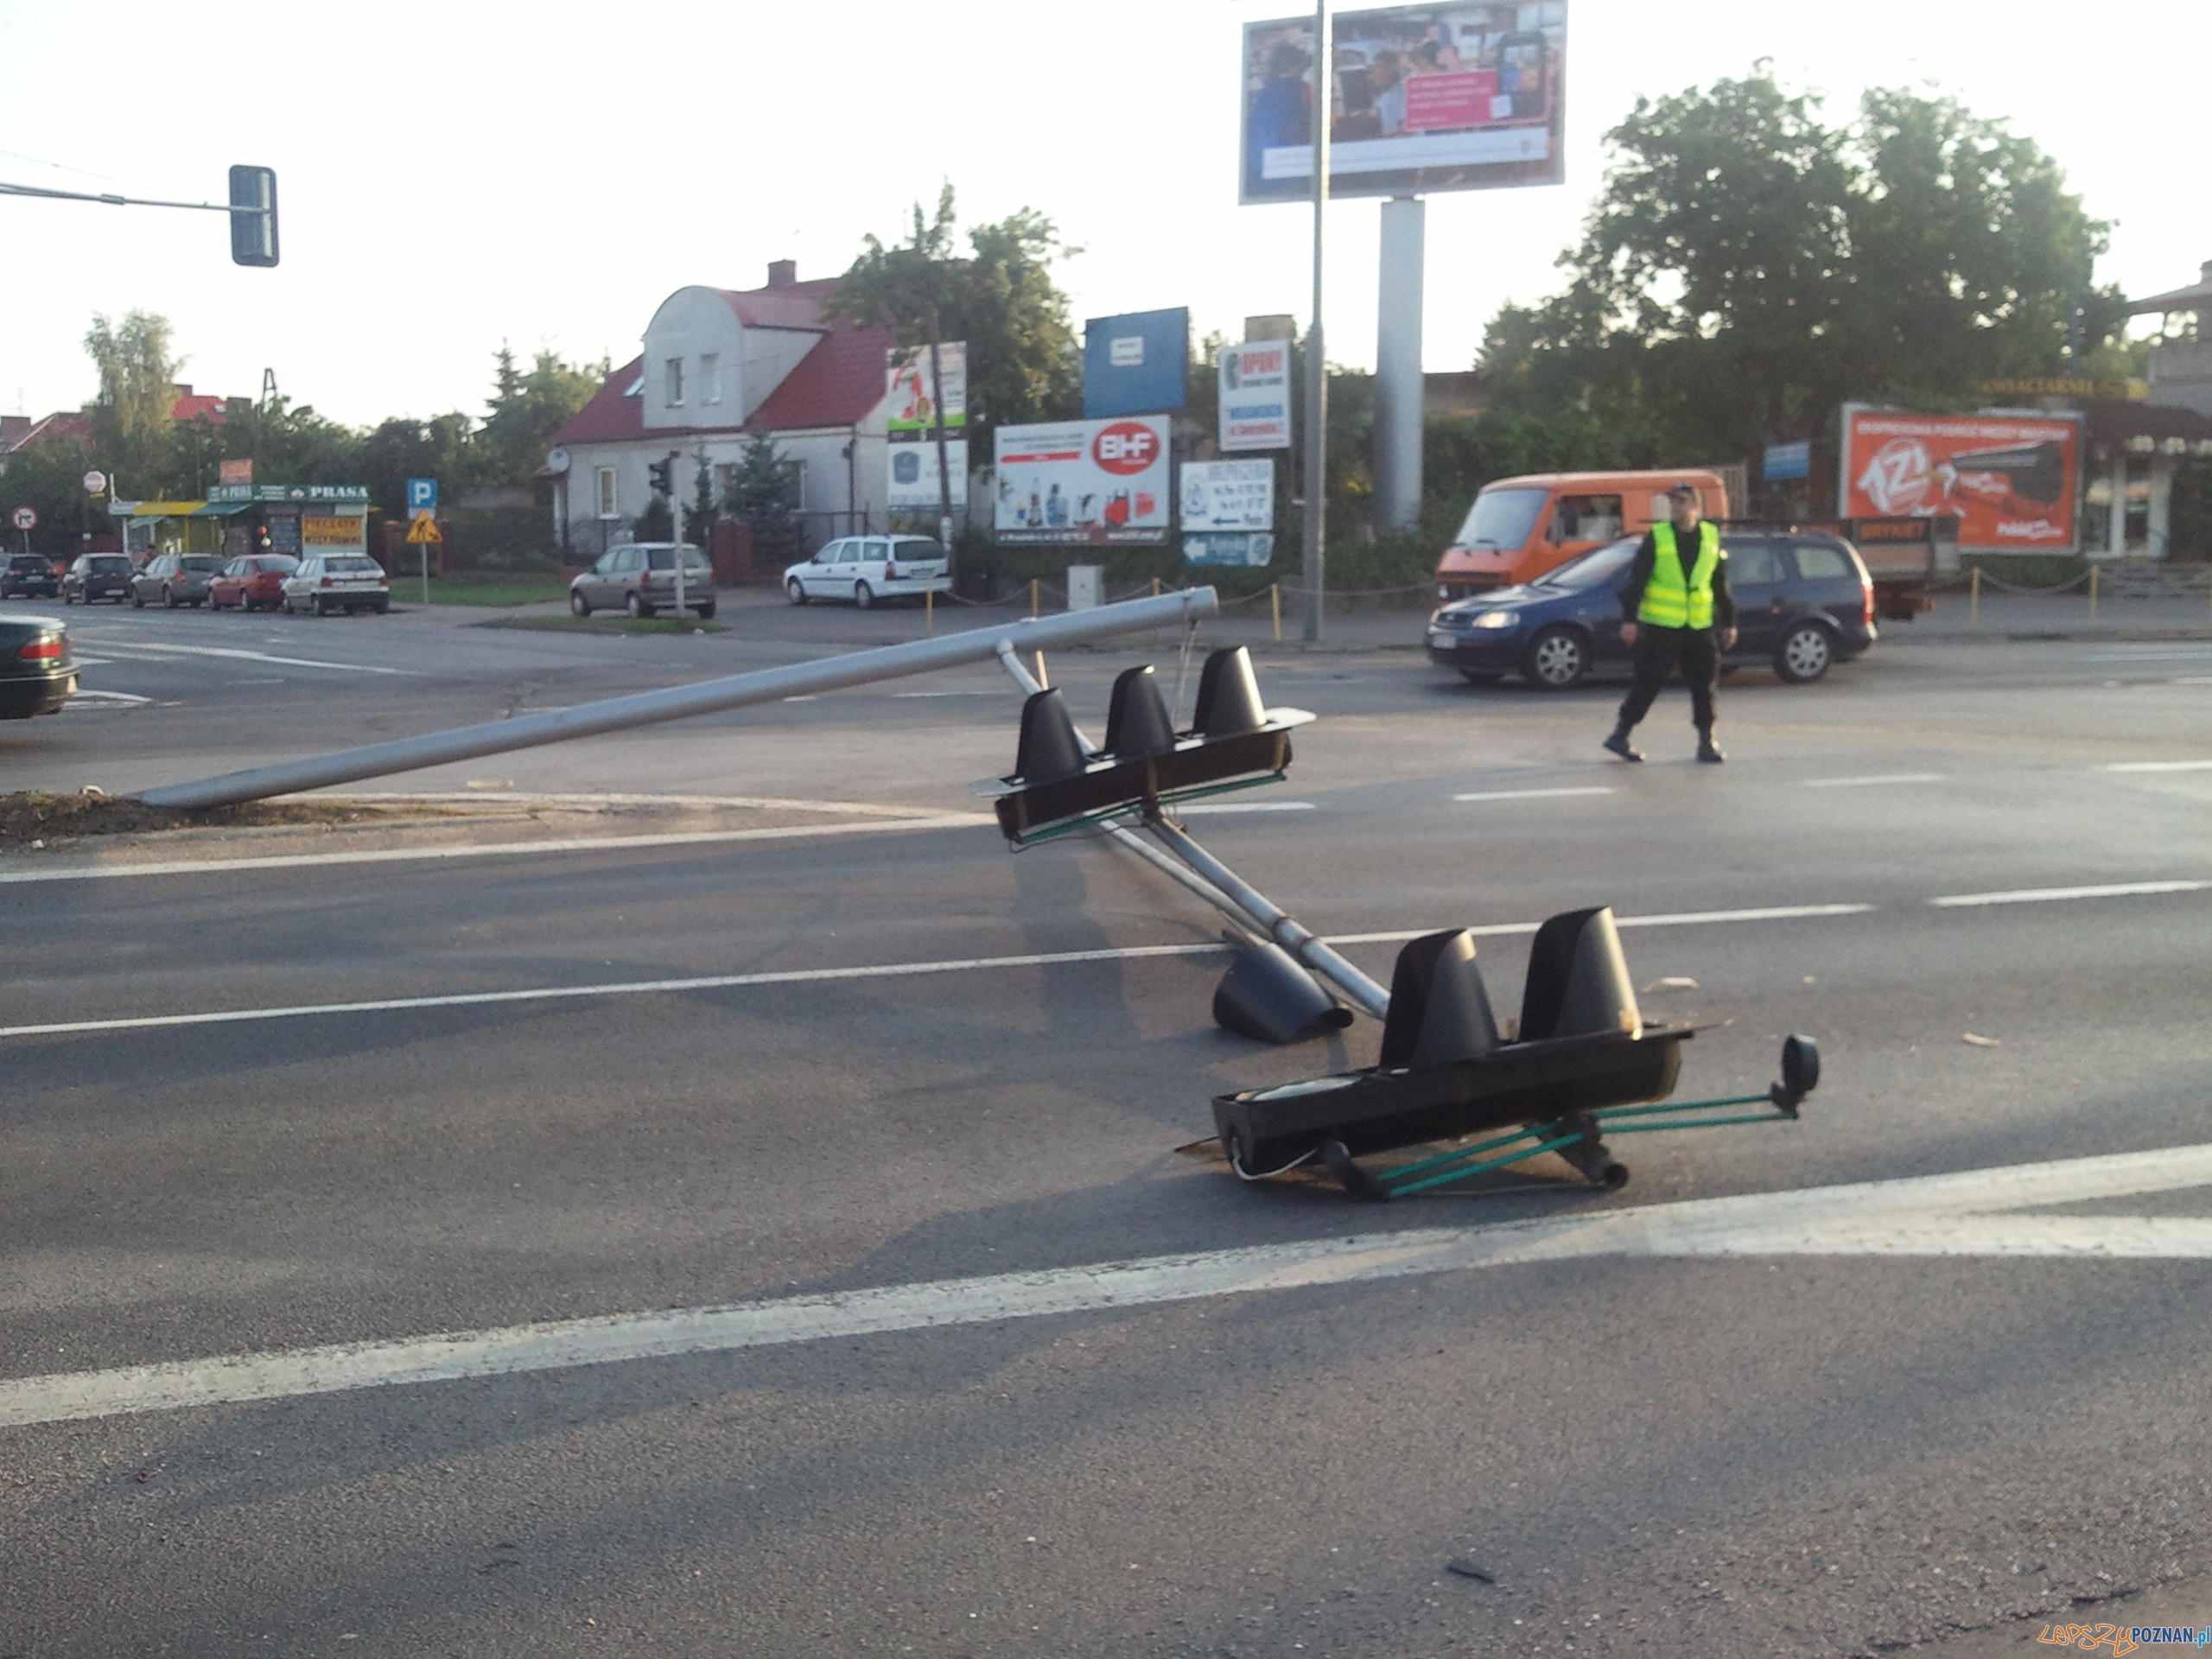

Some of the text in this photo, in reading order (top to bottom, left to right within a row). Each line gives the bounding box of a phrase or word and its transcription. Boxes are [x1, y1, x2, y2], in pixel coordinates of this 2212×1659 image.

[1100, 432, 1152, 460] BHF
[310, 485, 369, 499] PRASA
[415, 481, 432, 505] P
